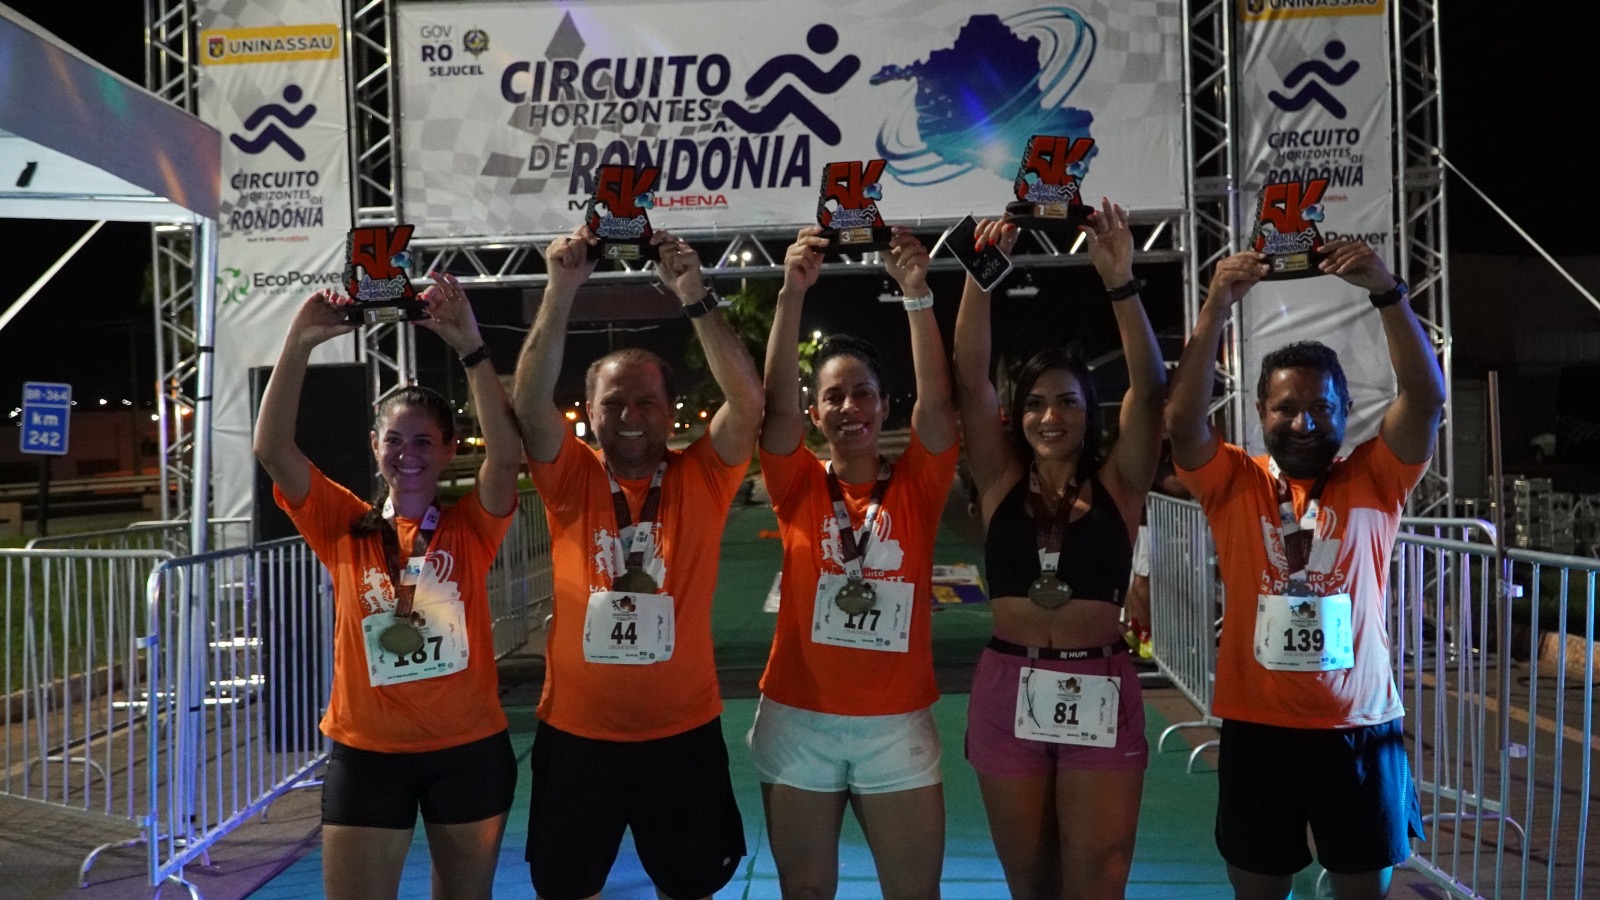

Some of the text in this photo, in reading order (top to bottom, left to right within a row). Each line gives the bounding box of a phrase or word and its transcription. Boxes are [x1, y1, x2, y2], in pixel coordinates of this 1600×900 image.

[420, 24, 453, 39] GOV
[229, 36, 334, 55] UNINASSAU
[421, 44, 454, 62] RO
[429, 65, 484, 77] SEJUCEL
[500, 53, 731, 103] CIRCUITO
[528, 99, 712, 127] HORIZONTES
[1267, 128, 1360, 148] CIRCUITO
[528, 144, 571, 172] DE
[1025, 134, 1095, 186] 5K
[1277, 148, 1350, 160] HORIZONTES
[231, 170, 319, 190] CIRCUITO
[826, 158, 887, 210] 5K
[239, 190, 311, 201] HORIZONTES
[597, 165, 660, 217] 5K
[654, 194, 728, 207] ILHENA
[1261, 179, 1328, 233] 5K
[230, 203, 324, 231] RONDÔNIA
[1324, 231, 1388, 245] Power
[253, 270, 343, 288] EcoPowe
[26, 388, 69, 402] BR-364
[32, 410, 59, 427] km
[28, 430, 61, 447] 242
[844, 609, 881, 632] 177
[610, 621, 638, 645] 44
[1283, 628, 1325, 652] 139
[1053, 701, 1079, 726] 81
